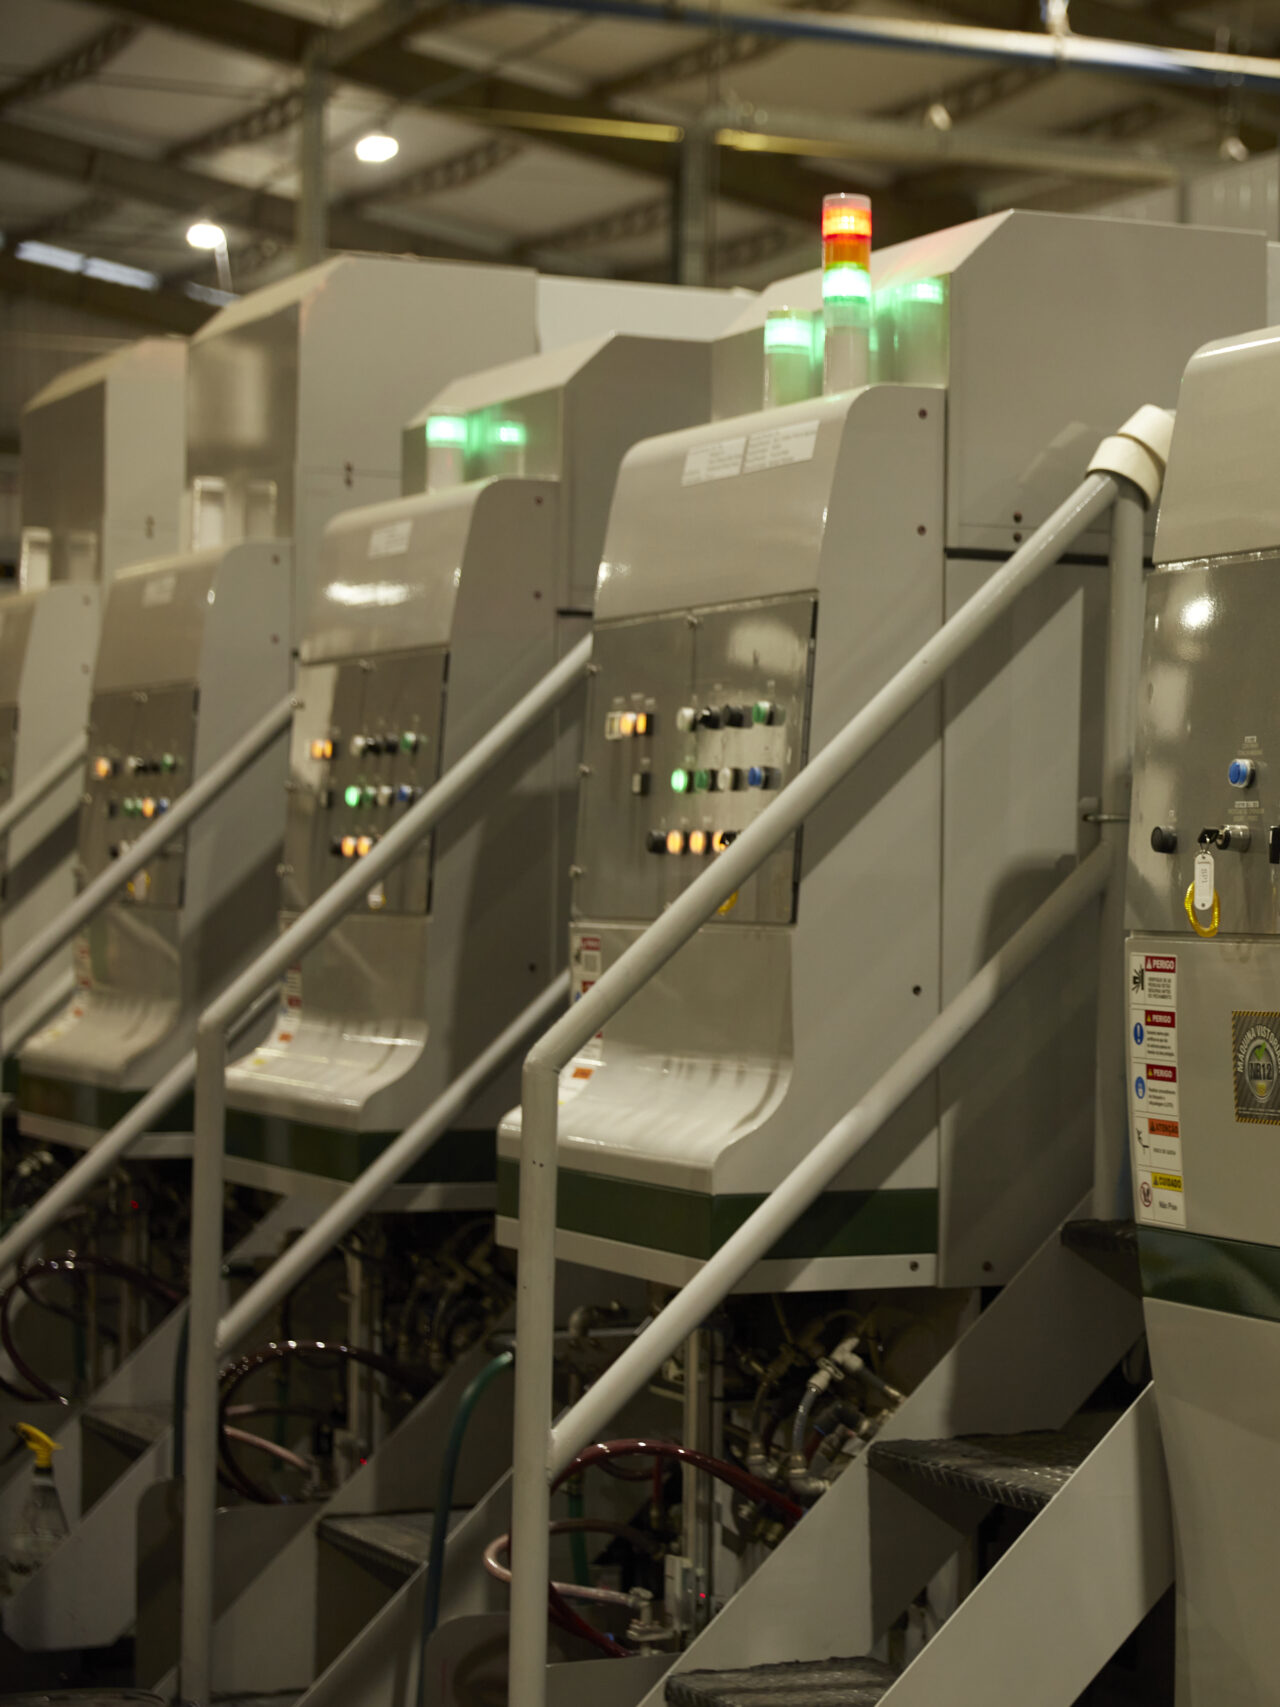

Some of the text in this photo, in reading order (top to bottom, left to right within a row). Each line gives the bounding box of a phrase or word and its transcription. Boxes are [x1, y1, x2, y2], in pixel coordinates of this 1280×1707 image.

[1152, 959, 1175, 970] PERIGO
[1152, 1014, 1172, 1024] PERIGO
[1153, 1068, 1173, 1079] PERIGO
[1249, 1062, 1272, 1081] NR12
[1159, 1176, 1182, 1189] CUIDADO
